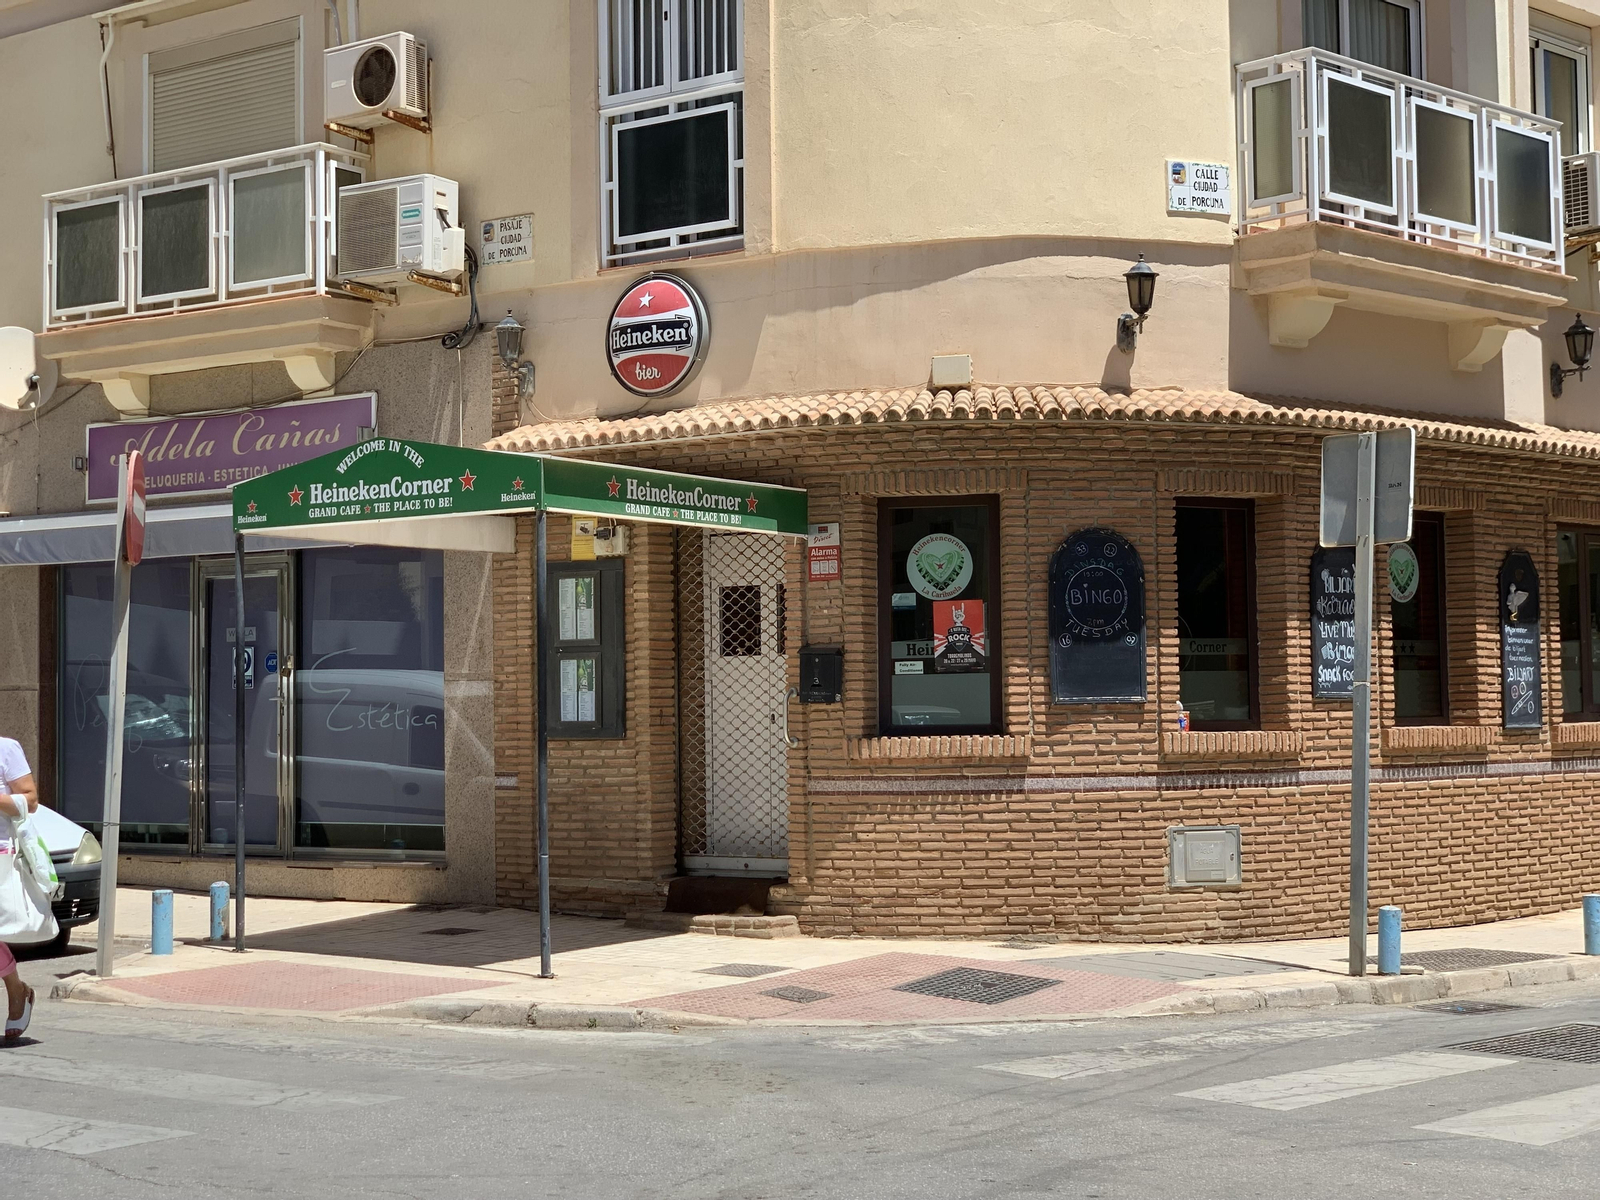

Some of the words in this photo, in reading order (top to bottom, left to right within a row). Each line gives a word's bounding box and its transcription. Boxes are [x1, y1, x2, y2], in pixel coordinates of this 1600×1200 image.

[1195, 169, 1219, 180] CALLE
[1193, 181, 1218, 192] CIUDAD
[1178, 197, 1186, 206] DE
[1192, 196, 1224, 209] PORCUNA
[500, 220, 522, 232] PASAJE
[500, 234, 522, 245] CIUDAD
[488, 252, 496, 260] DE
[500, 245, 528, 258] PORCUNA
[612, 324, 688, 350] Heineken
[635, 362, 661, 380] bier
[110, 418, 216, 468] Adela
[232, 412, 344, 455] Cañas
[336, 440, 386, 474] WELCOME
[388, 440, 402, 452] IN
[404, 445, 424, 468] THE
[144, 467, 205, 488] ELUQUERÍA
[214, 466, 268, 482] ESTETICA
[310, 476, 454, 504] HeinekenCorner
[501, 490, 536, 502] Heineken
[626, 478, 742, 511] HeinekenCorner
[308, 504, 337, 518] GRAND
[340, 504, 361, 515] CAFE
[374, 502, 390, 513] THE
[394, 499, 421, 512] PLACE
[424, 498, 436, 509] TO
[438, 496, 453, 508] BE!
[625, 502, 650, 515] GRAND
[652, 506, 670, 518] CAFE
[680, 508, 694, 520] THE
[696, 511, 718, 522] PLACE
[719, 513, 728, 524] TO
[730, 514, 742, 525] BE!
[238, 514, 268, 524] Heineken
[810, 548, 838, 556] Alarma
[912, 536, 966, 556] Heinekencorner
[1076, 544, 1086, 554] 33
[1064, 558, 1125, 580] DINSDAG
[921, 586, 930, 596] La
[932, 584, 962, 598] Carihuela
[1065, 618, 1130, 638] TUESDAY
[948, 634, 970, 642] ROCK
[1062, 635, 1071, 646] 16
[906, 644, 934, 656] Hei
[1190, 640, 1227, 652] Corner
[309, 648, 438, 732] Estética
